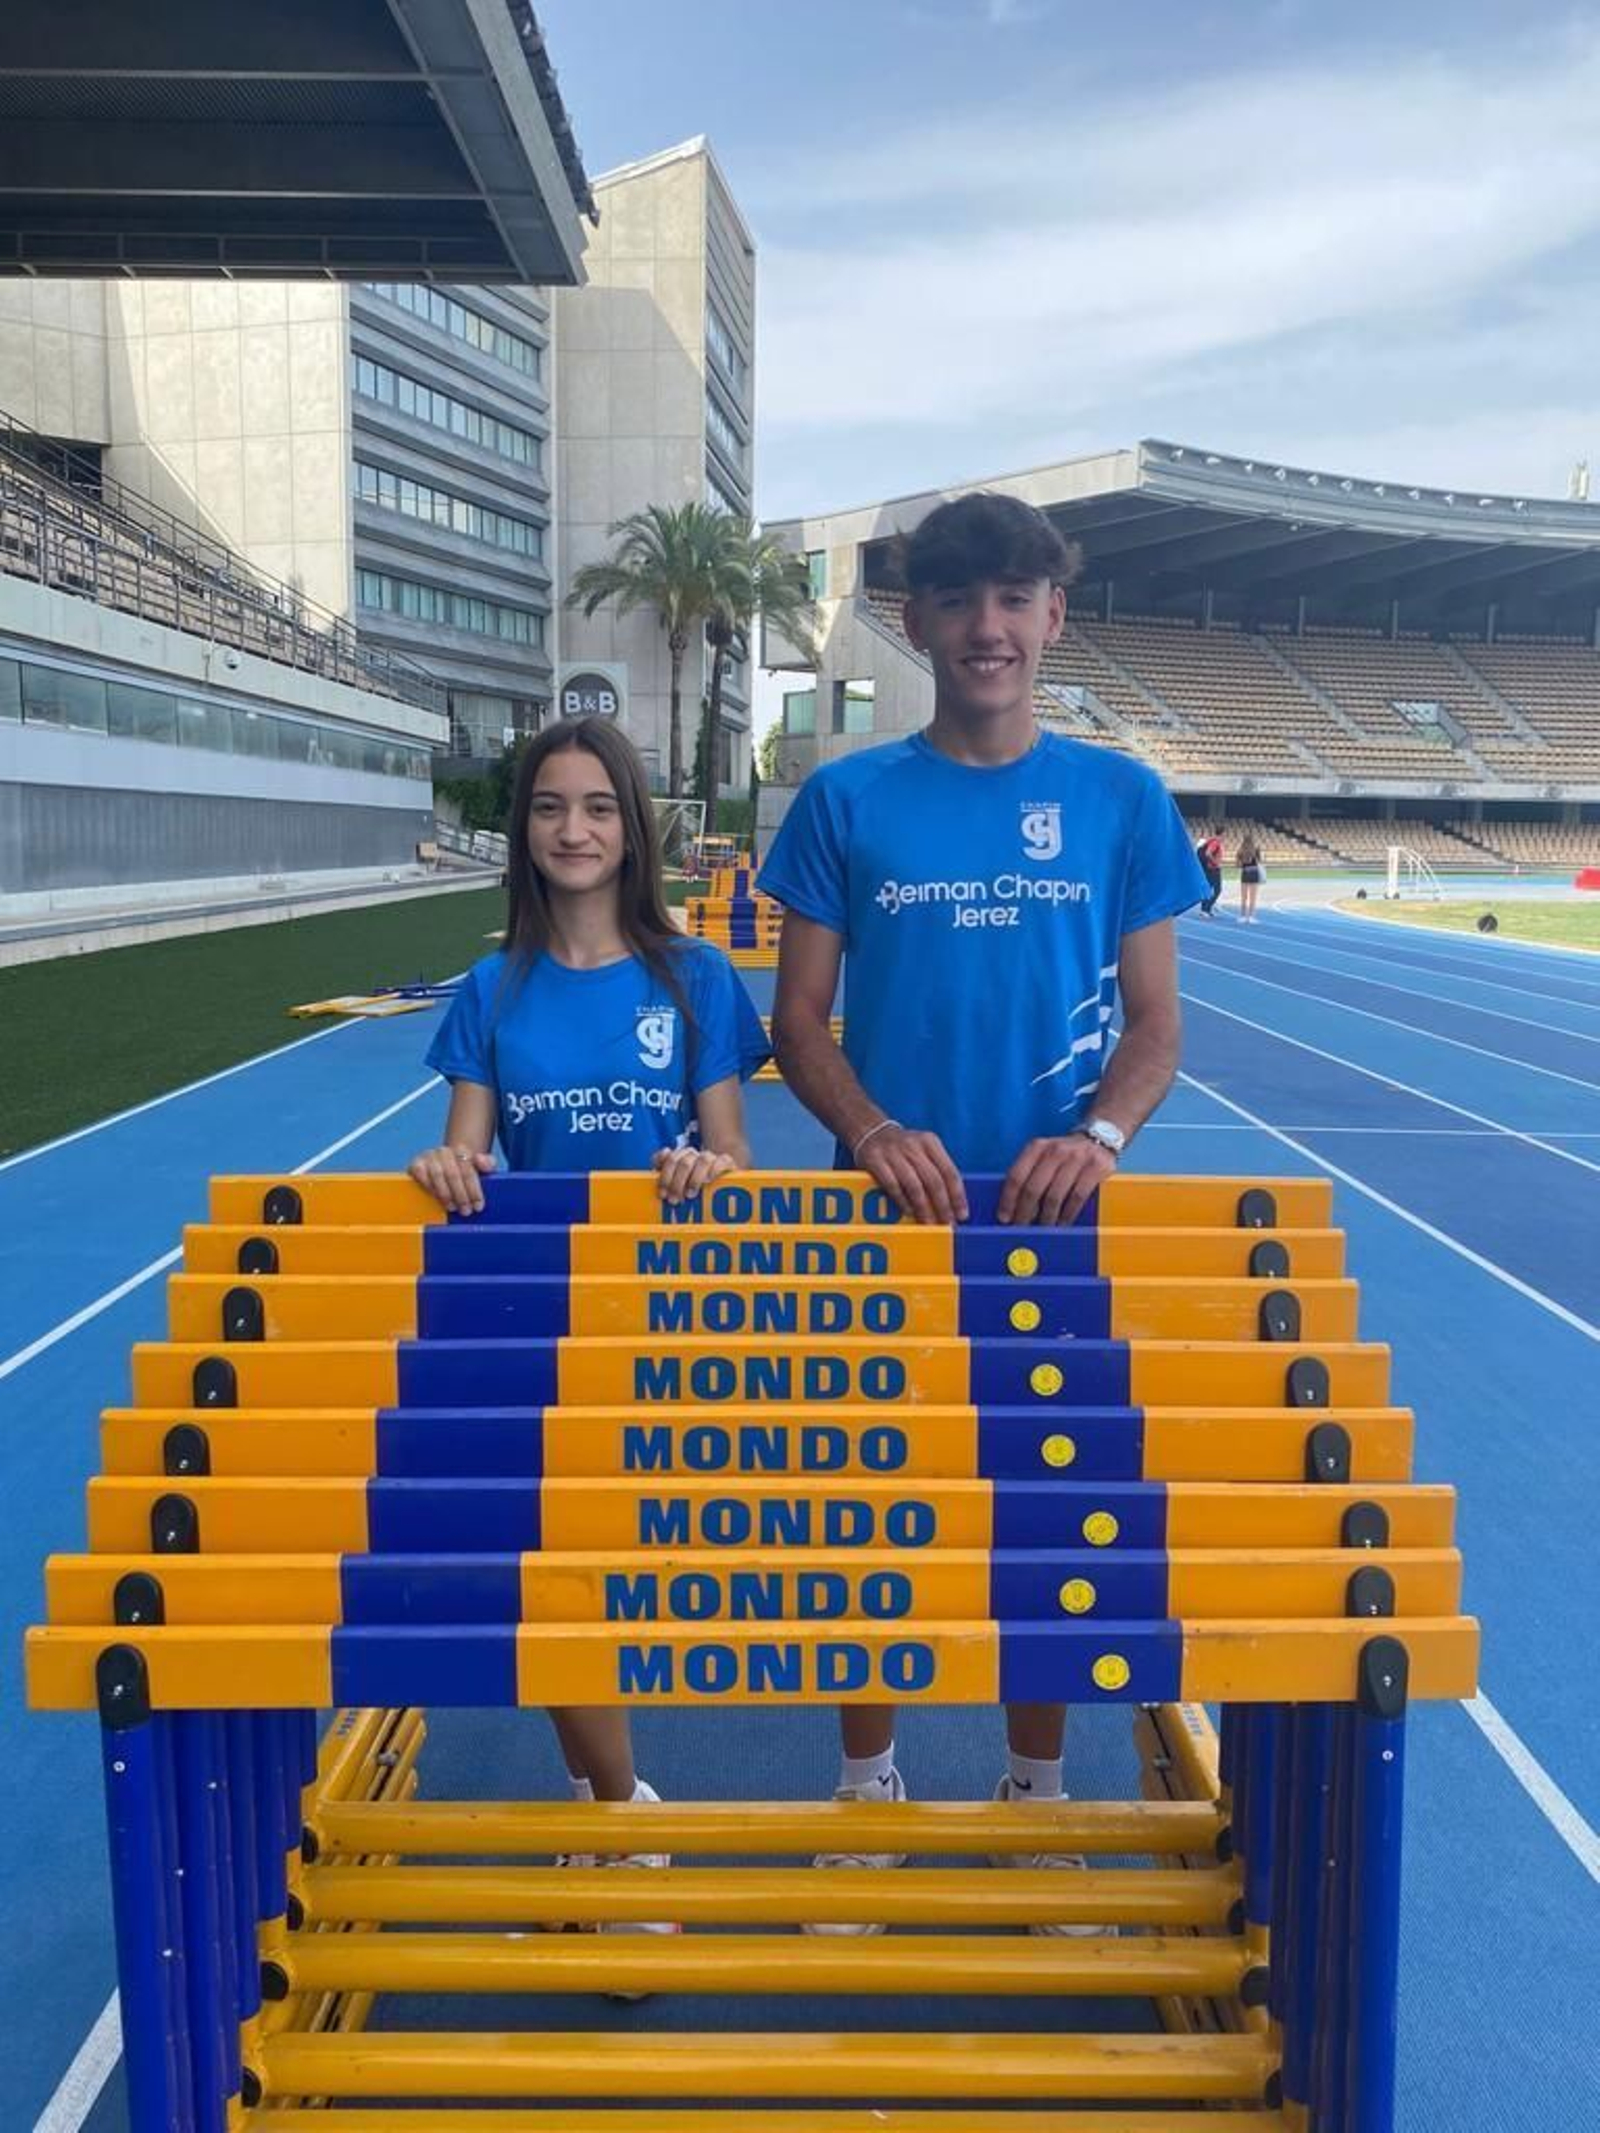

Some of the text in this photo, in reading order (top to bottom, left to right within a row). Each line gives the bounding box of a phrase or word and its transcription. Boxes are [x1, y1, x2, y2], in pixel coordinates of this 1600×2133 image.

[565, 690, 616, 713] B&B
[993, 874, 1090, 907] Chapin
[952, 904, 1020, 928] Jerez
[569, 1110, 634, 1133] Jerez
[662, 1186, 903, 1224] MONDO
[639, 1240, 889, 1275] MONDO
[649, 1291, 906, 1333] MONDO
[635, 1356, 906, 1400] MONDO
[624, 1426, 908, 1471] MONDO
[639, 1499, 936, 1547] MONDO
[605, 1573, 912, 1620] MONDO
[619, 1643, 935, 1693] MONDO
